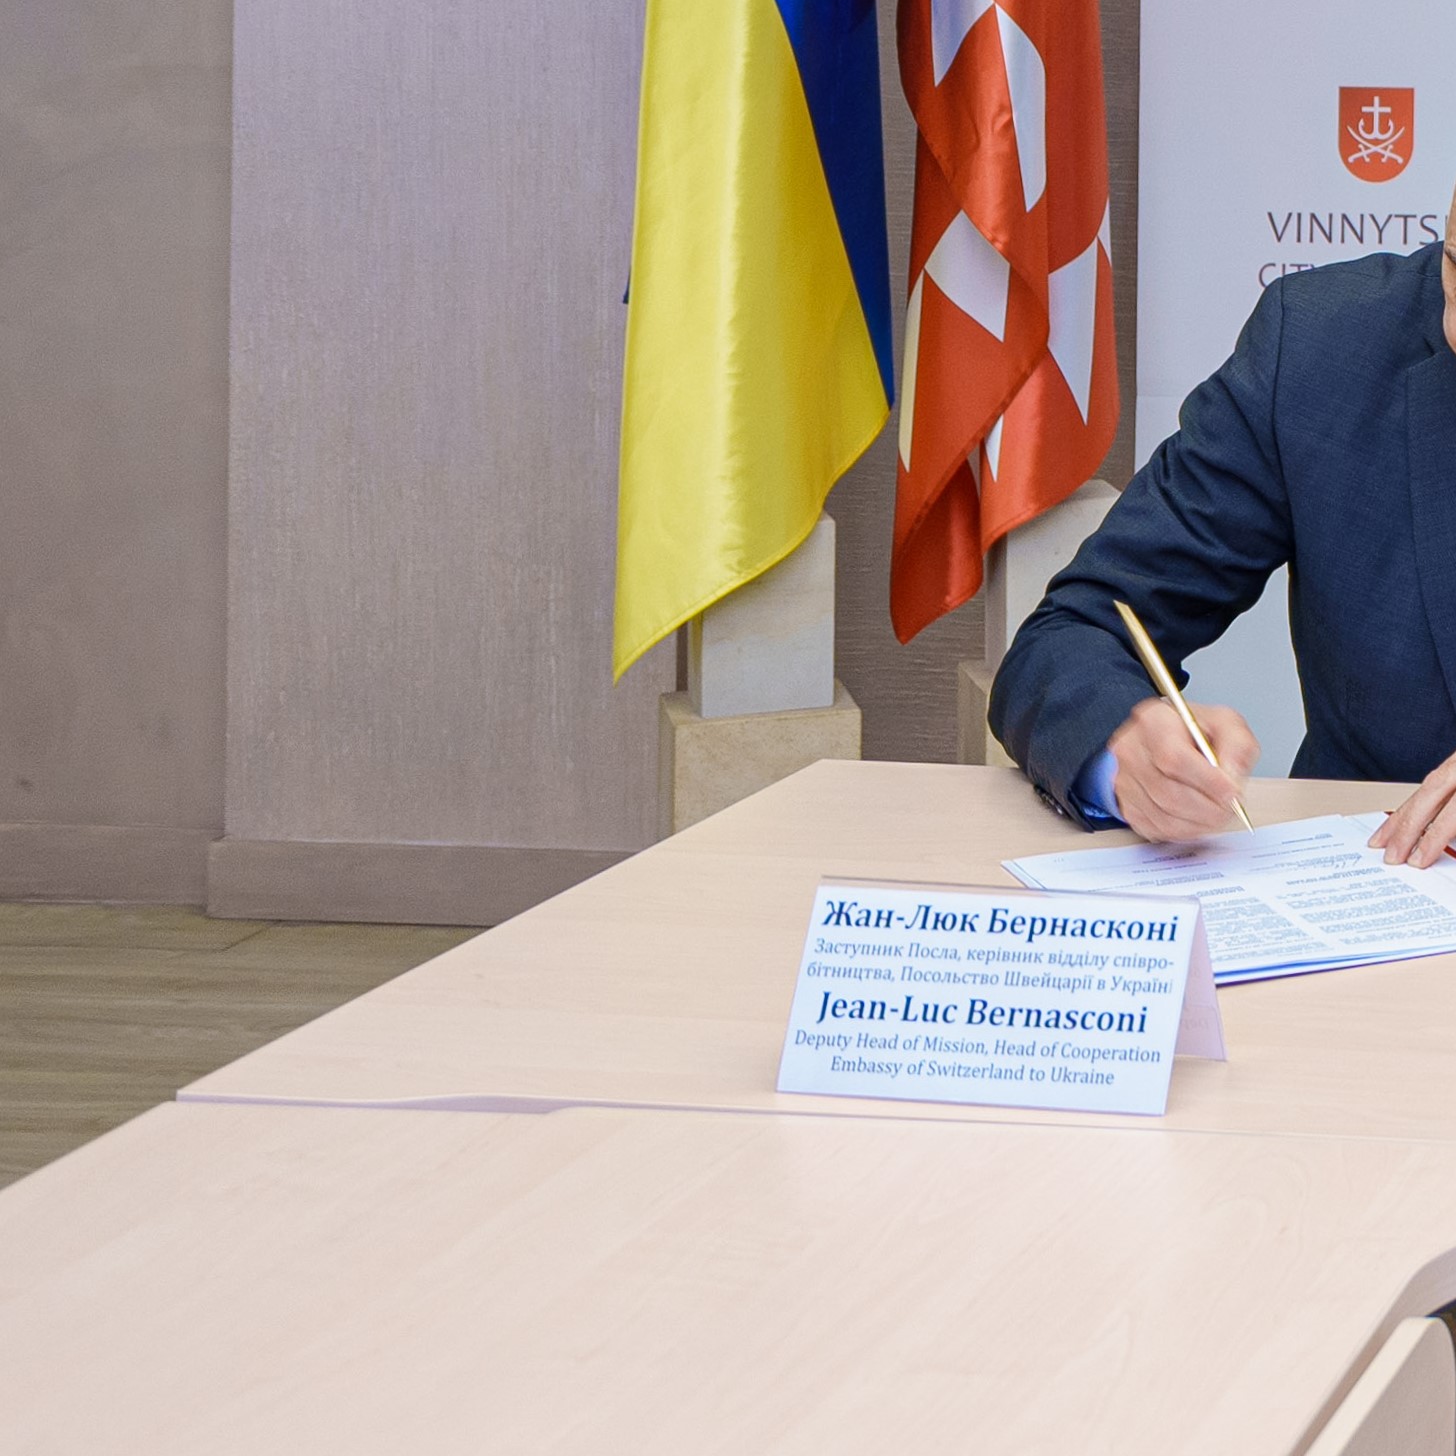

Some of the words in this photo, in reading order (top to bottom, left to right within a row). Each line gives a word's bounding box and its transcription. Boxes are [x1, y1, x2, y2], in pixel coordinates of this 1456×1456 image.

[1267, 211, 1449, 245] VINNYTS
[821, 900, 979, 933] Жан-Люк
[987, 907, 1180, 944] Бернасконі
[814, 937, 904, 959] Заступник
[907, 942, 962, 962] Посла,
[966, 946, 1044, 966] керівник
[1047, 949, 1109, 971] відділу
[1113, 952, 1175, 973] співро-
[806, 961, 896, 983] бітництва,
[900, 965, 999, 986] Посольство
[1003, 970, 1095, 994] Швейцарії
[1096, 978, 1106, 991] в
[816, 990, 959, 1025] Jean-Luc
[965, 997, 1148, 1034] Bernasconi
[794, 1029, 853, 1052] Deputy
[856, 1032, 899, 1051] Head
[902, 1034, 923, 1052] of
[923, 1035, 989, 1057] Mission,
[994, 1039, 1037, 1058] Head
[1040, 1041, 1060, 1059] of
[1060, 1042, 1162, 1065] Cooperation
[830, 1054, 903, 1079] Embassy
[906, 1058, 927, 1077] of
[926, 1059, 1026, 1082] Switzerland
[1029, 1067, 1046, 1082] to
[1050, 1066, 1116, 1086] Ukraine
